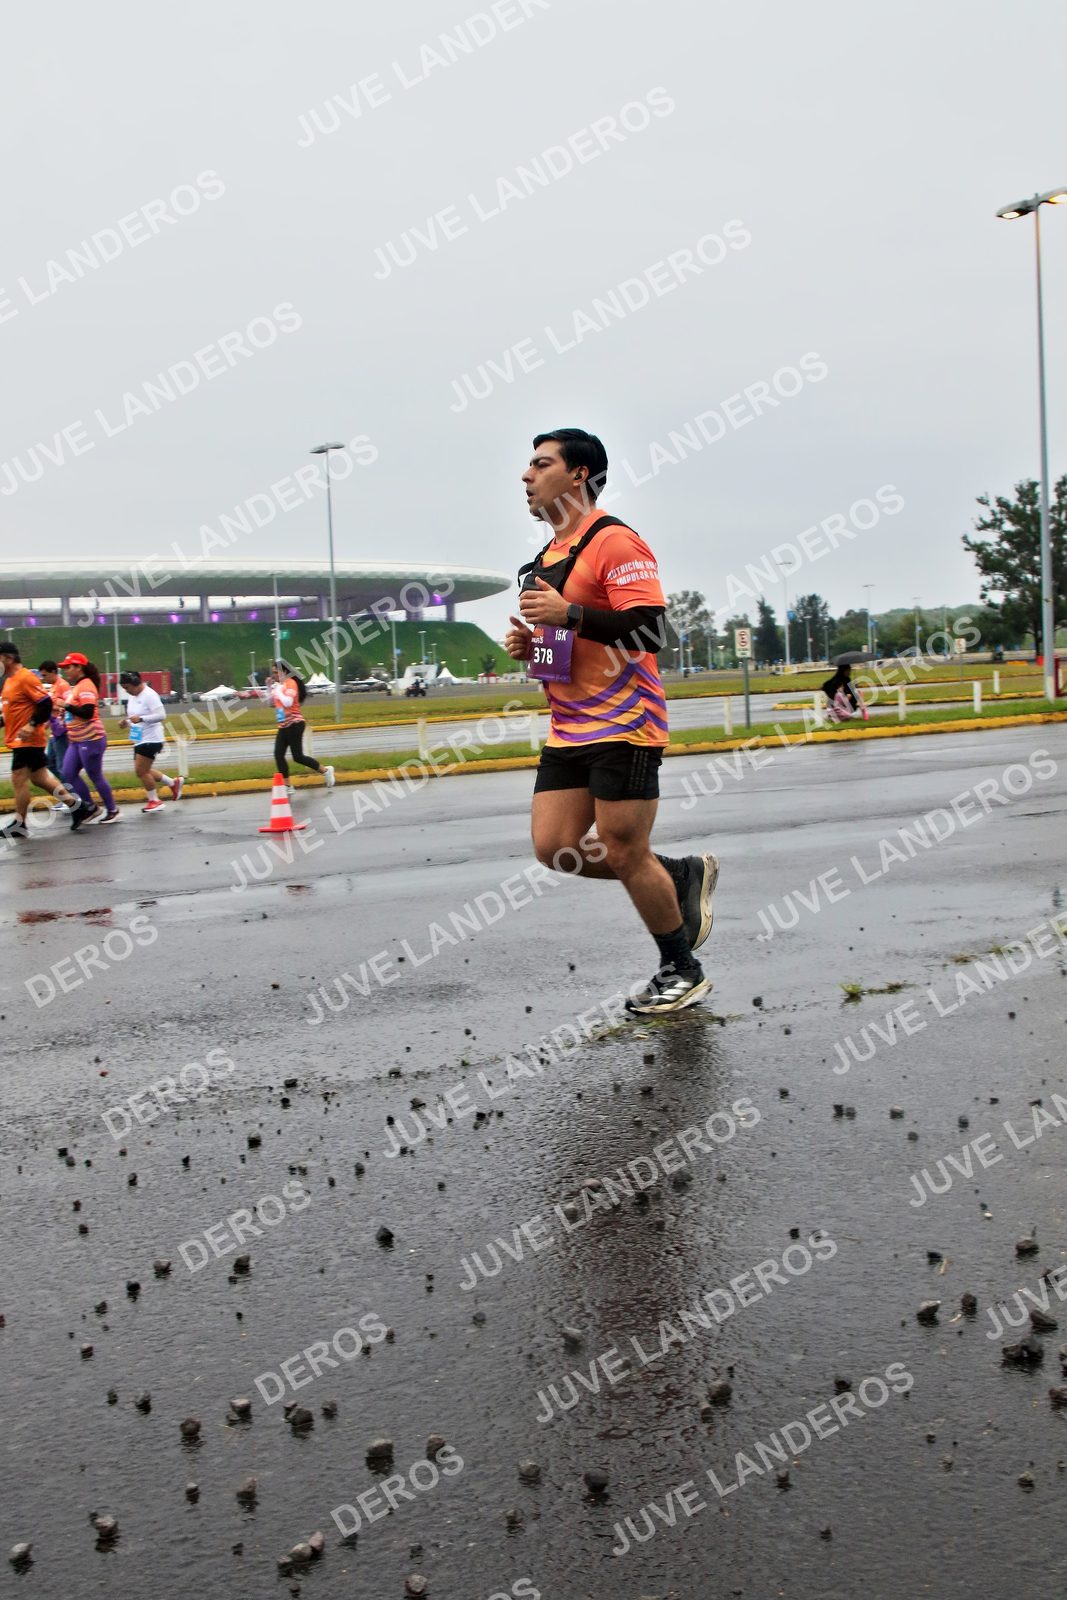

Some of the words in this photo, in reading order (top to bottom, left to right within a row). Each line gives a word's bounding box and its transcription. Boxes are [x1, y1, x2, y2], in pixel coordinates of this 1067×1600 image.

[616, 570, 649, 587] IMPULSA
[555, 629, 568, 641] 15K
[533, 647, 553, 665] 378
